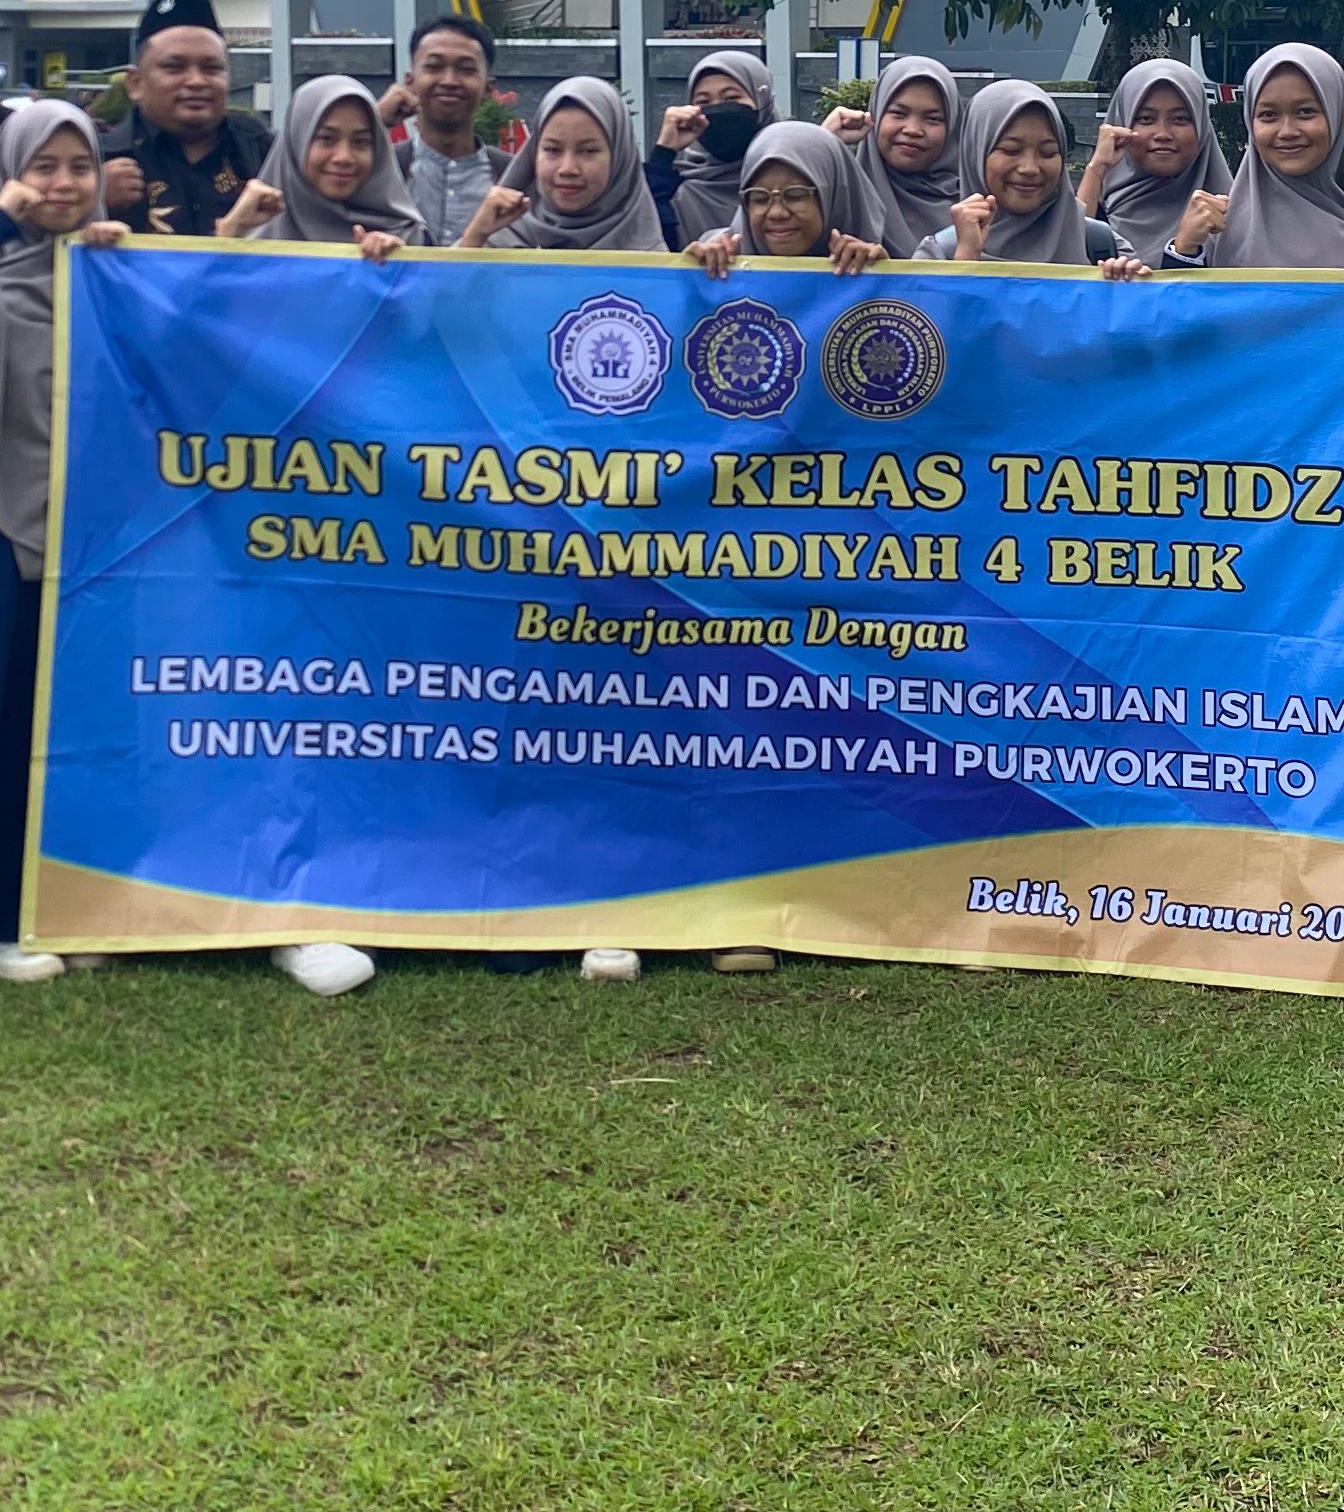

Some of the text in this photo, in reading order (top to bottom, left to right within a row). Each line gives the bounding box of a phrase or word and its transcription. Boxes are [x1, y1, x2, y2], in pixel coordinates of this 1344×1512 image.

[574, 310, 657, 356] MUHAMMADIYAH
[841, 306, 925, 331] MUHAMMADIYAH
[917, 326, 939, 397] PURWOKERTO
[861, 402, 902, 414] LPPI
[157, 429, 385, 496] UJIAN
[711, 451, 965, 511] KELAS
[246, 514, 1247, 593] SMA MUHAMMADIYAH 4 BELIK
[516, 601, 968, 661] Bekerjasama Dengan
[131, 656, 372, 697] LEMBAGA
[386, 660, 730, 710] PENGAMALAN
[745, 674, 852, 714] DAN
[866, 676, 1189, 727] PENGKAJIAN
[167, 719, 1318, 799] UNIVERSITAS MUHAMMADIYAH PURWOKERTO
[967, 877, 1079, 926] Belik,
[1089, 886, 1135, 924] 16
[1141, 889, 1293, 938] Januari
